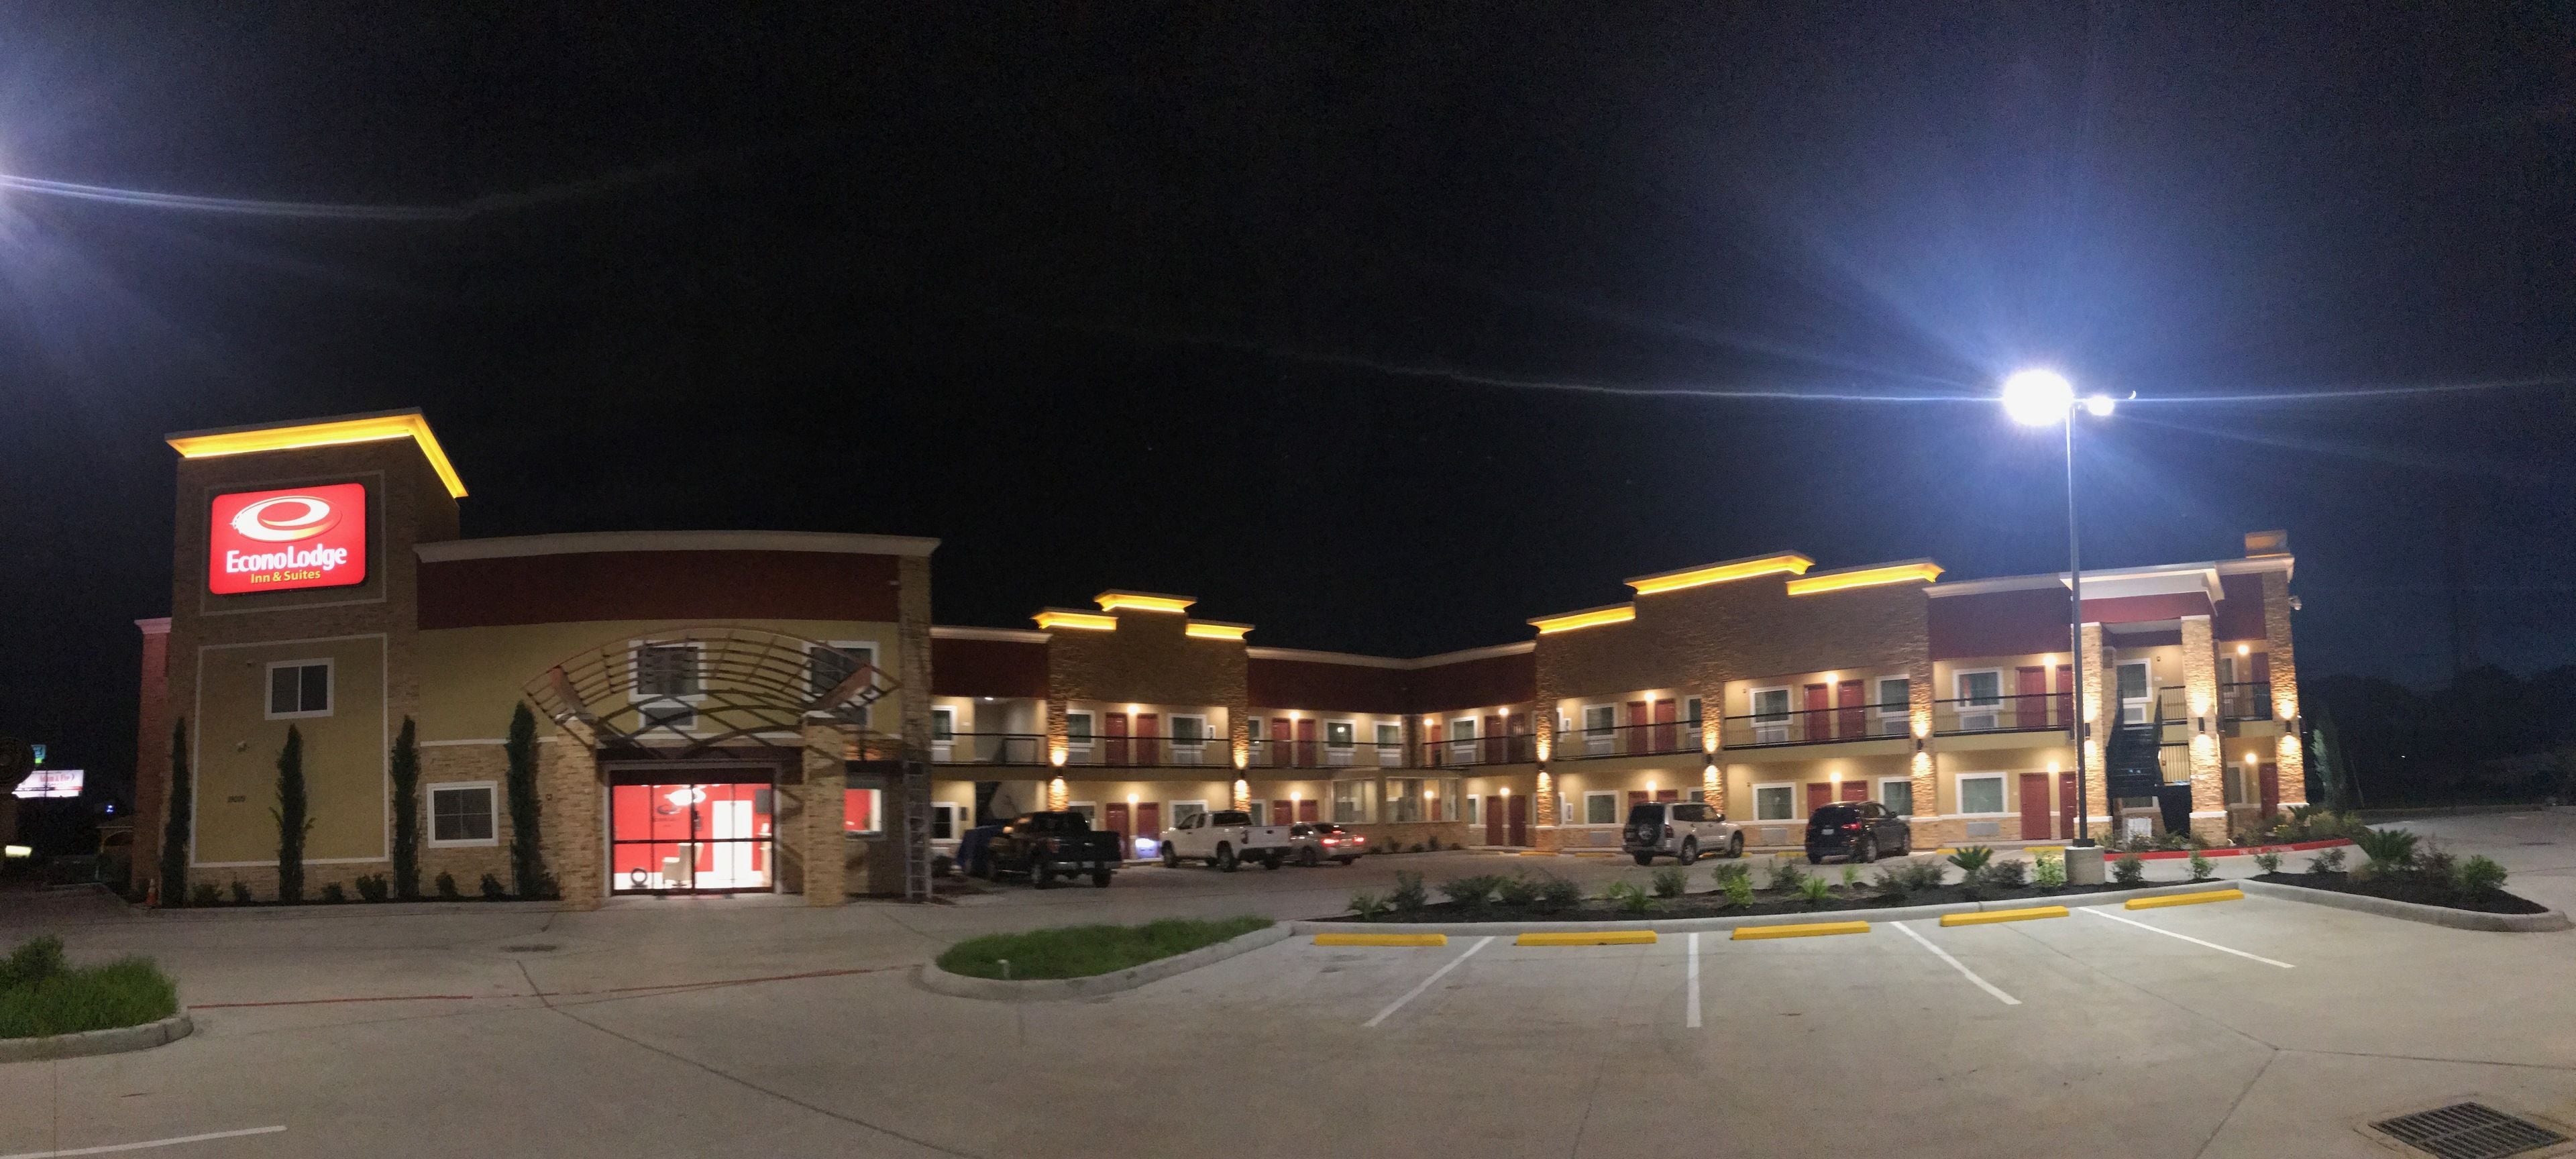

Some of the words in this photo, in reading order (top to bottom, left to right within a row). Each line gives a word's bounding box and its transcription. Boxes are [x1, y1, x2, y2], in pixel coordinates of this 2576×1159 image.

[227, 543, 347, 573] EconoLodge
[251, 573, 270, 584] Inn
[272, 571, 282, 582] &
[284, 570, 321, 582] Suites
